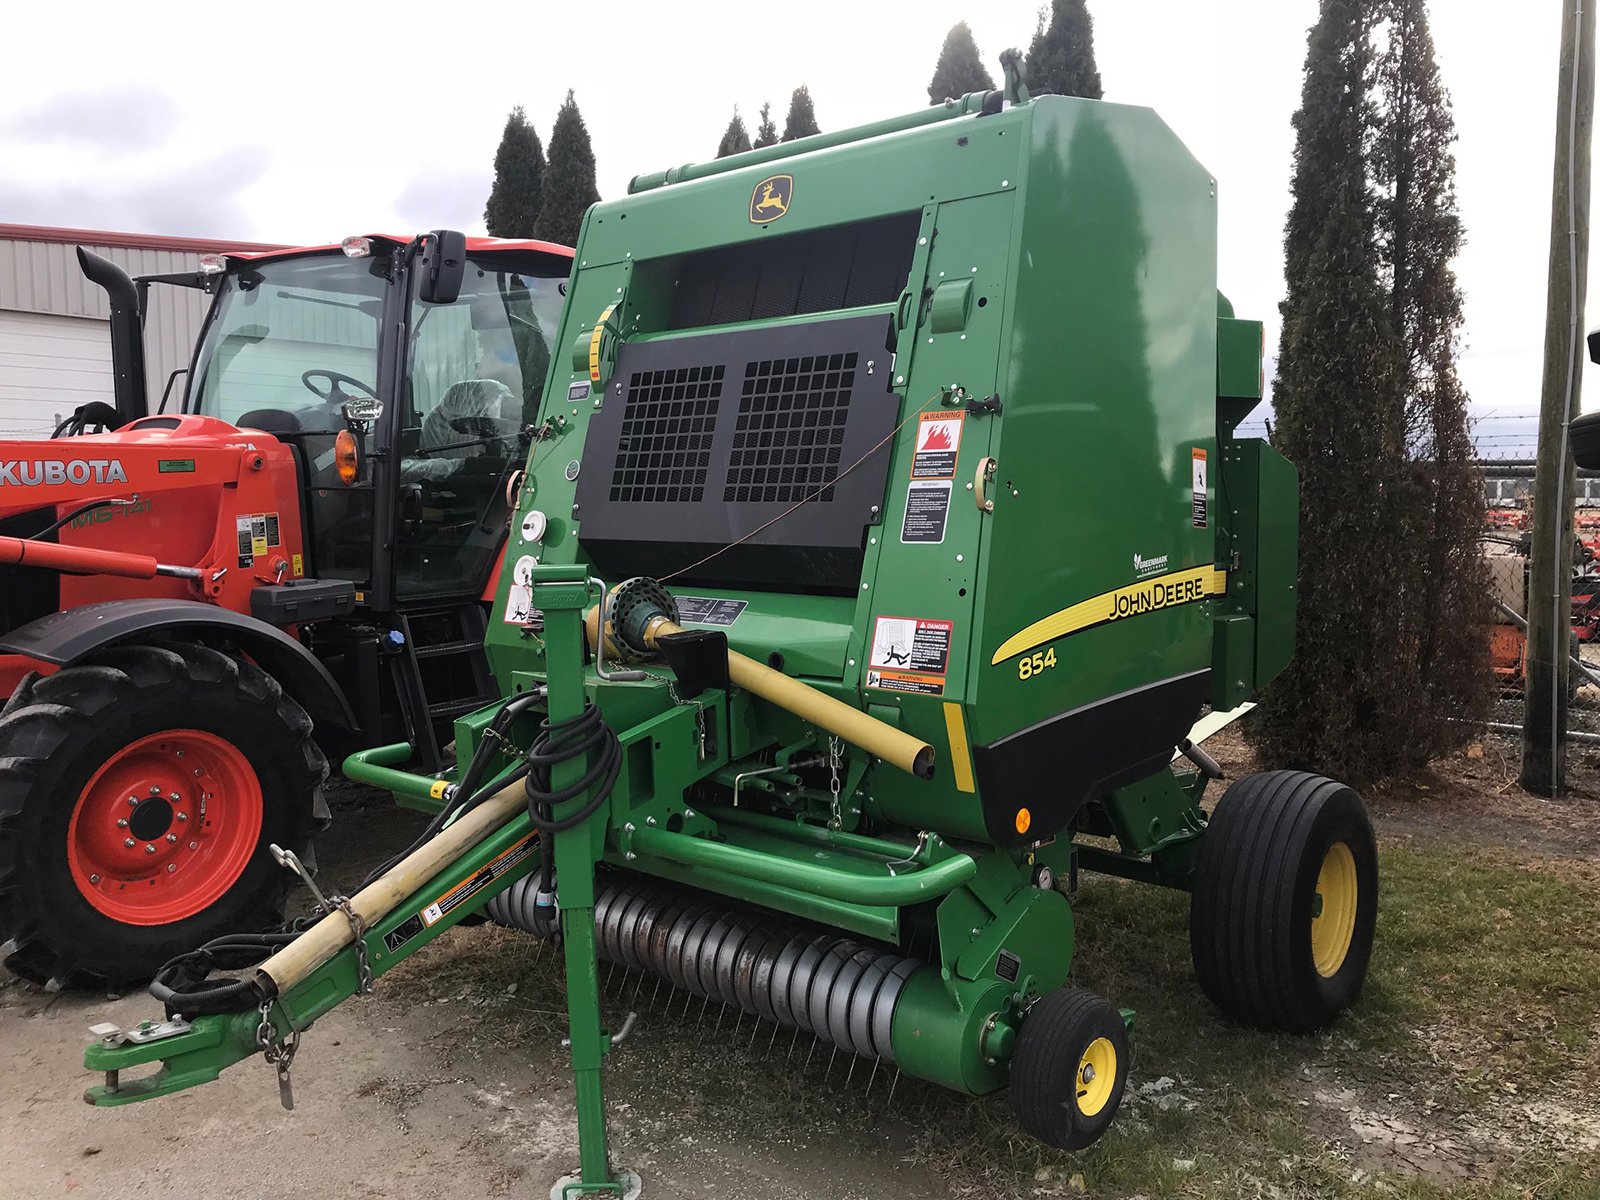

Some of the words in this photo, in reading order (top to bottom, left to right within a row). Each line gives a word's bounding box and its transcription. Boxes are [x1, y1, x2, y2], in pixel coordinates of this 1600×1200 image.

[930, 411, 961, 419] WARNING
[0, 459, 129, 486] KUBOTA
[1139, 554, 1169, 569] GREENMARK
[1109, 589, 1151, 619] JOHN
[1153, 577, 1204, 609] DEERE
[1018, 646, 1057, 680] 854
[902, 674, 923, 682] WARNING
